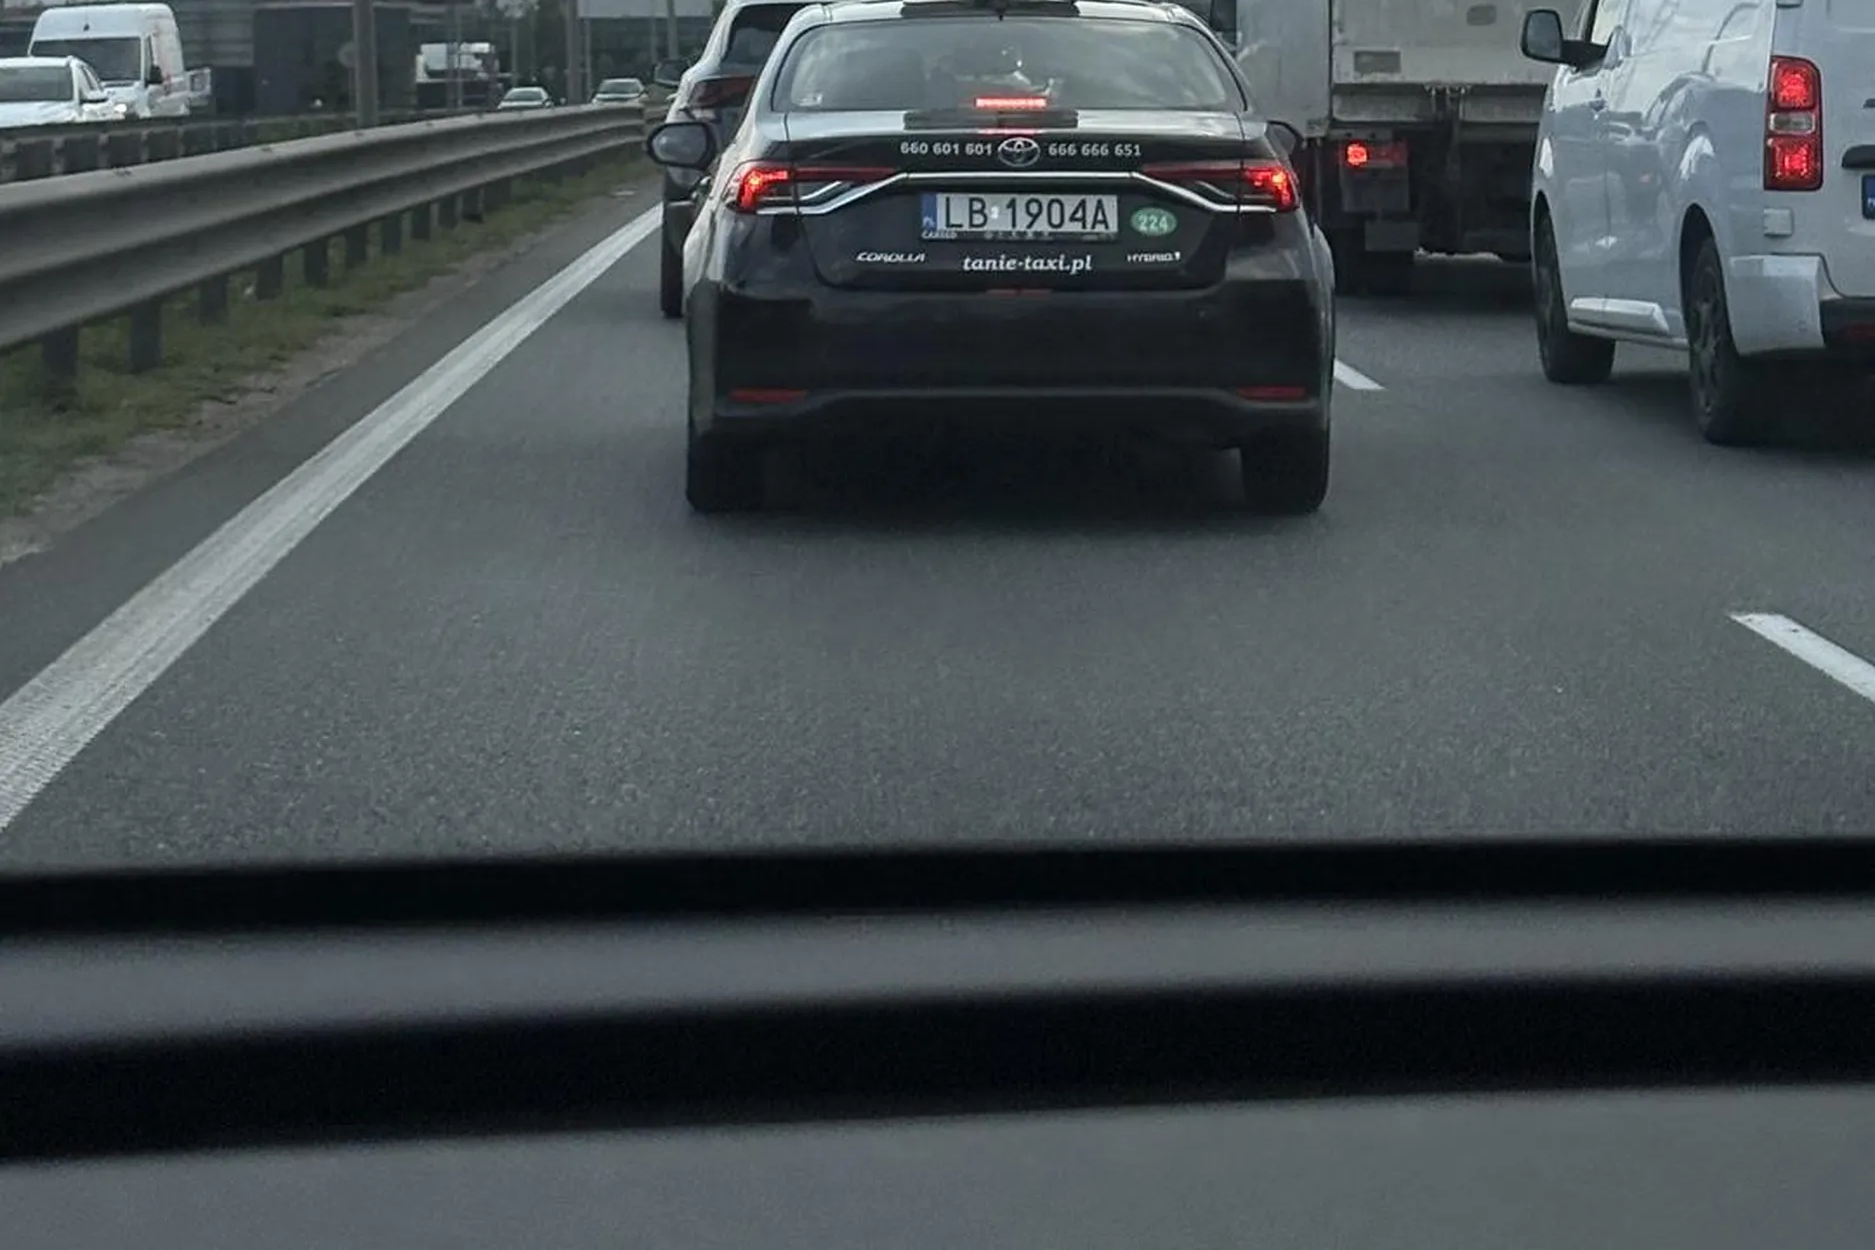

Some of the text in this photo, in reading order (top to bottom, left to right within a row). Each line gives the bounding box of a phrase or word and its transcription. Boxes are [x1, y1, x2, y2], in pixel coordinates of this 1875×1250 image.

[900, 141, 992, 155] 660 601 601
[1048, 142, 1141, 156] 666 666 651
[945, 197, 1110, 230] LB 1904A
[1138, 214, 1168, 231] 224
[856, 251, 926, 262] COROLLA
[963, 253, 1093, 275] tanie-taxi.pl
